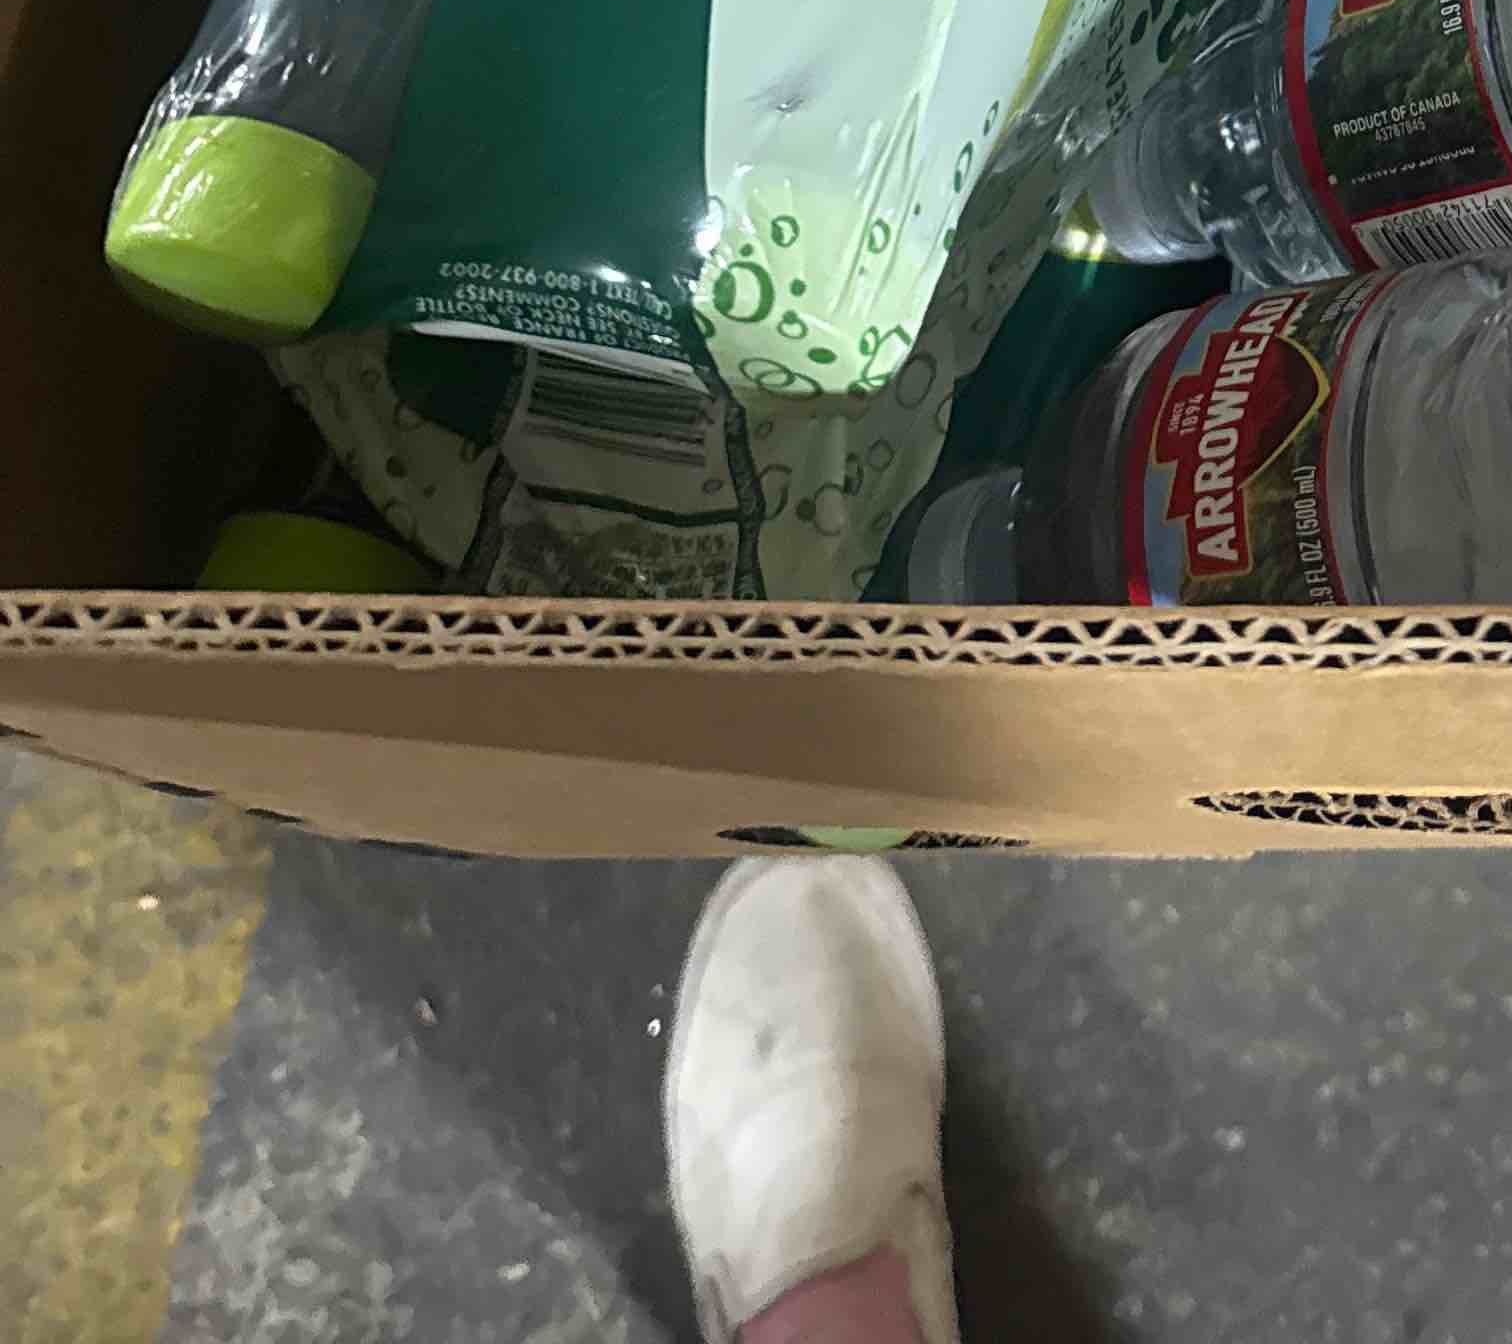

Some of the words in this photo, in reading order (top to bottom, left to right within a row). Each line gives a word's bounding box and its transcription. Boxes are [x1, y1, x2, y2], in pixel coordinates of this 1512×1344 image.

[1439, 3, 1464, 35] 16.9
[1333, 110, 1388, 139] PRODUCT
[1390, 104, 1408, 122] OF
[1409, 90, 1461, 117] CANADA
[439, 262, 599, 296] 1-800-937-2002
[454, 282, 582, 313] COMMENTS?
[1195, 296, 1297, 562] ARROWHEAD
[1293, 464, 1317, 495] mL)
[1295, 497, 1323, 538] (500
[1299, 540, 1323, 562] OZ
[1306, 564, 1328, 586] FL
